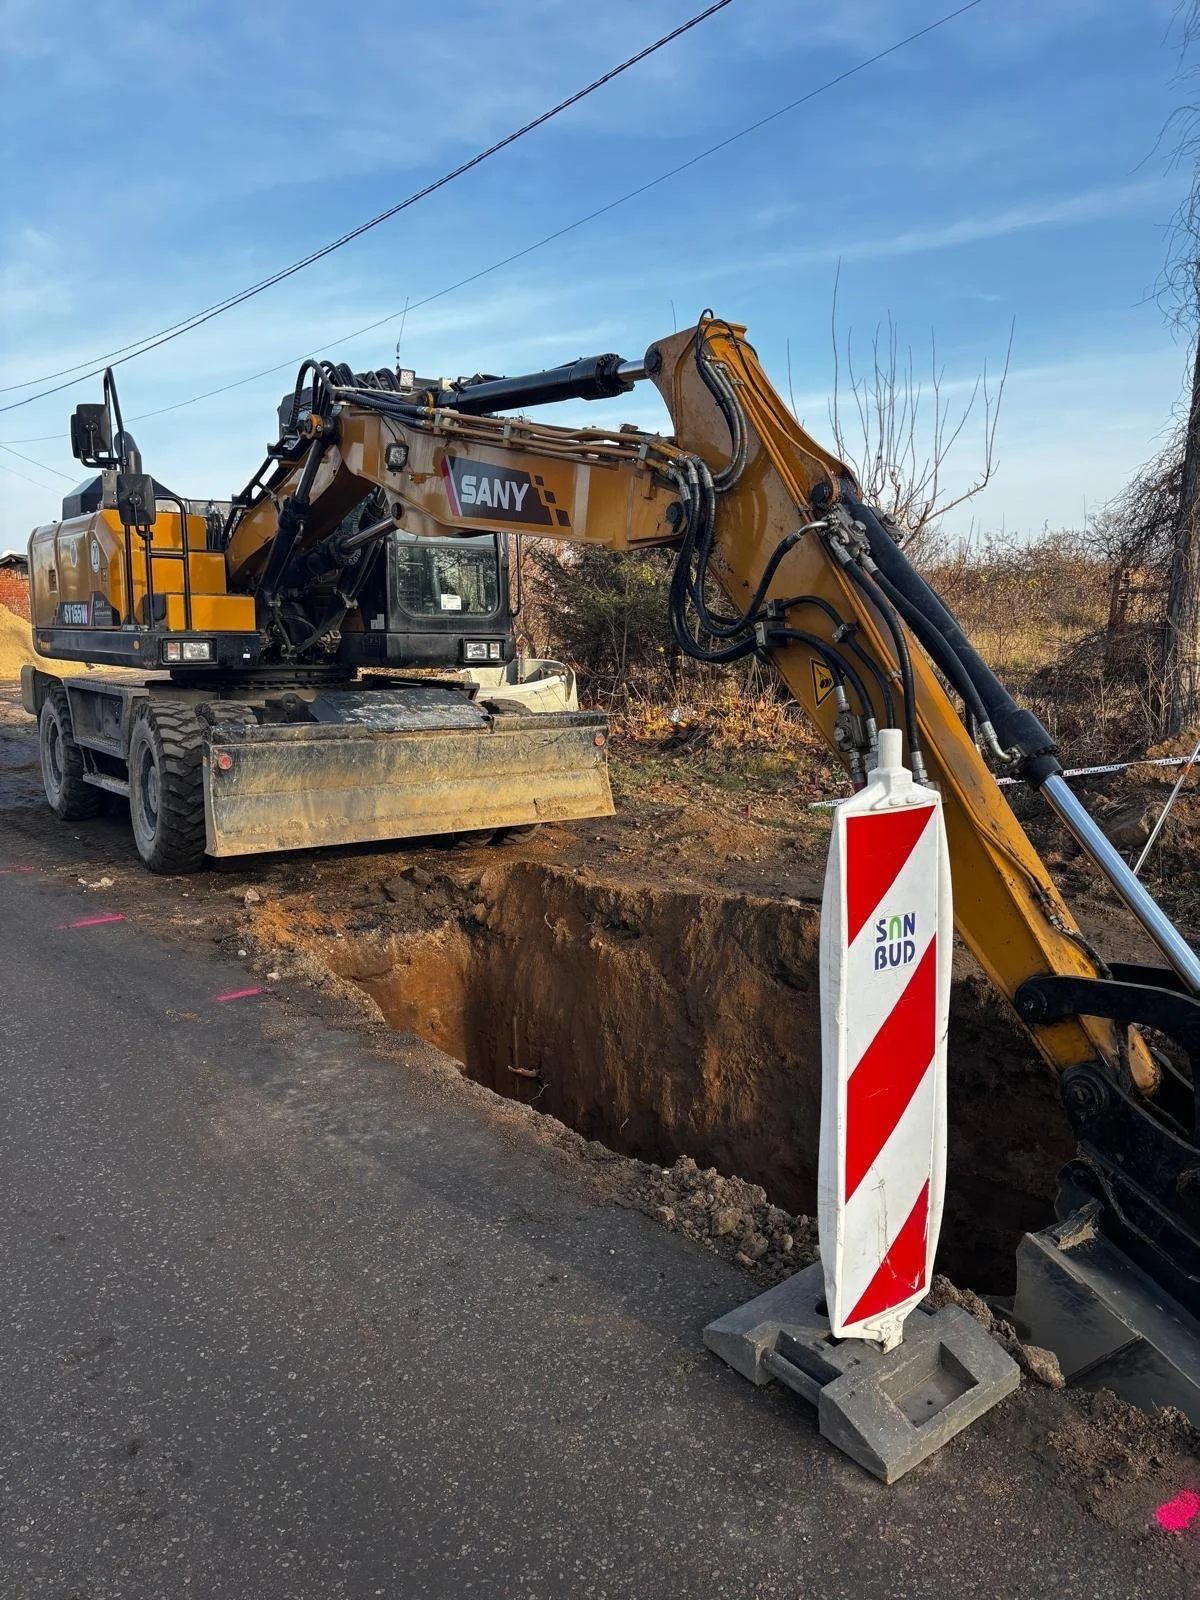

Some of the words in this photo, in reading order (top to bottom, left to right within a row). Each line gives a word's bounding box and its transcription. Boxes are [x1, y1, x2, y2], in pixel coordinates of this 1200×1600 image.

[461, 475, 530, 512] SANY
[64, 604, 88, 624] SY155W
[875, 940, 916, 970] BUD
